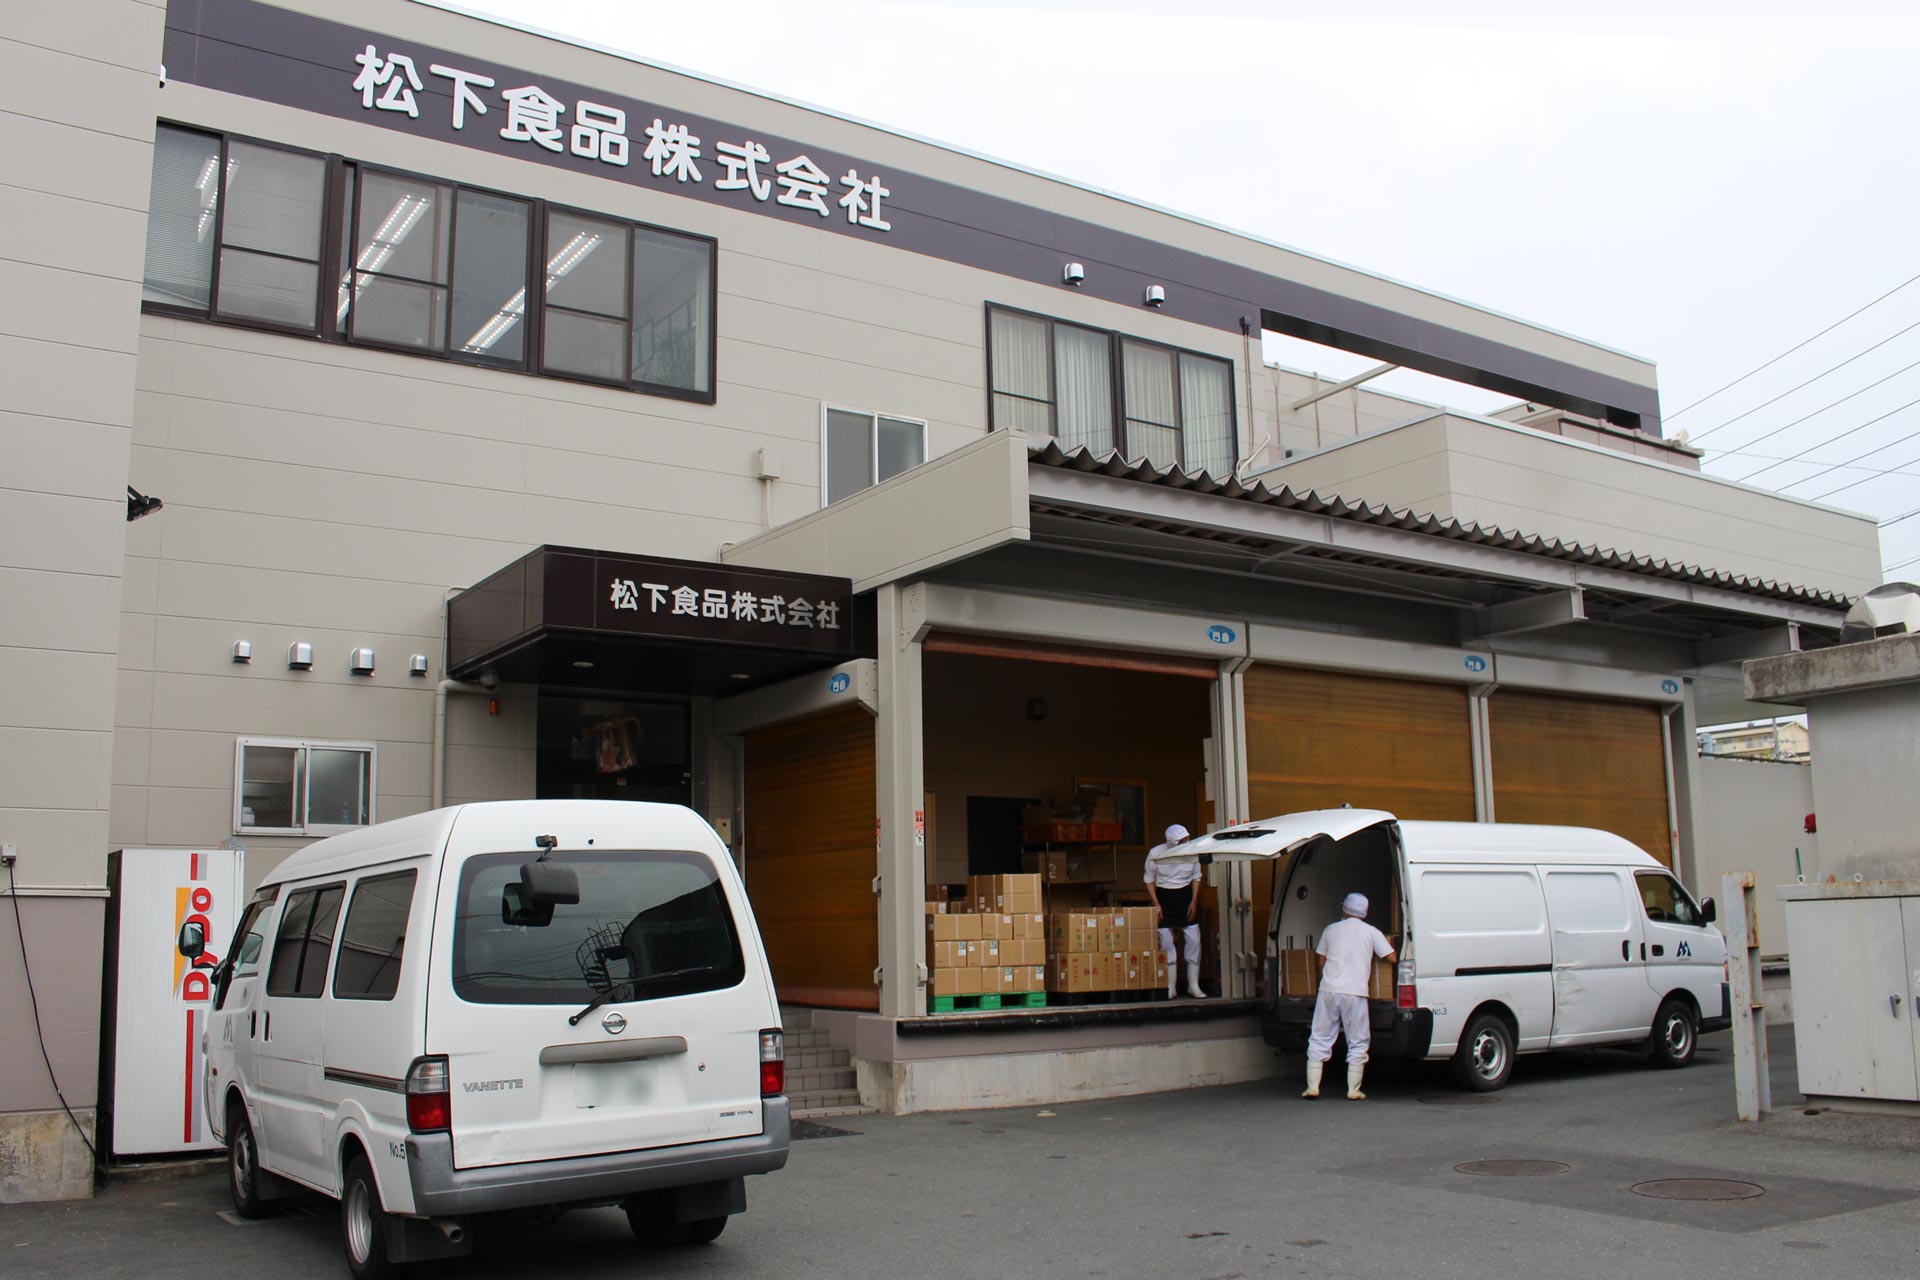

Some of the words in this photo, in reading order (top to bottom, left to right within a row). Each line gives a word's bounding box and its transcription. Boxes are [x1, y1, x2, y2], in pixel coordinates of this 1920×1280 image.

[353, 44, 891, 231] 松下食品株式会社
[610, 578, 841, 630] 松下食品株式会社
[462, 1078, 525, 1093] VANETTE
[389, 1141, 406, 1159] No.5
